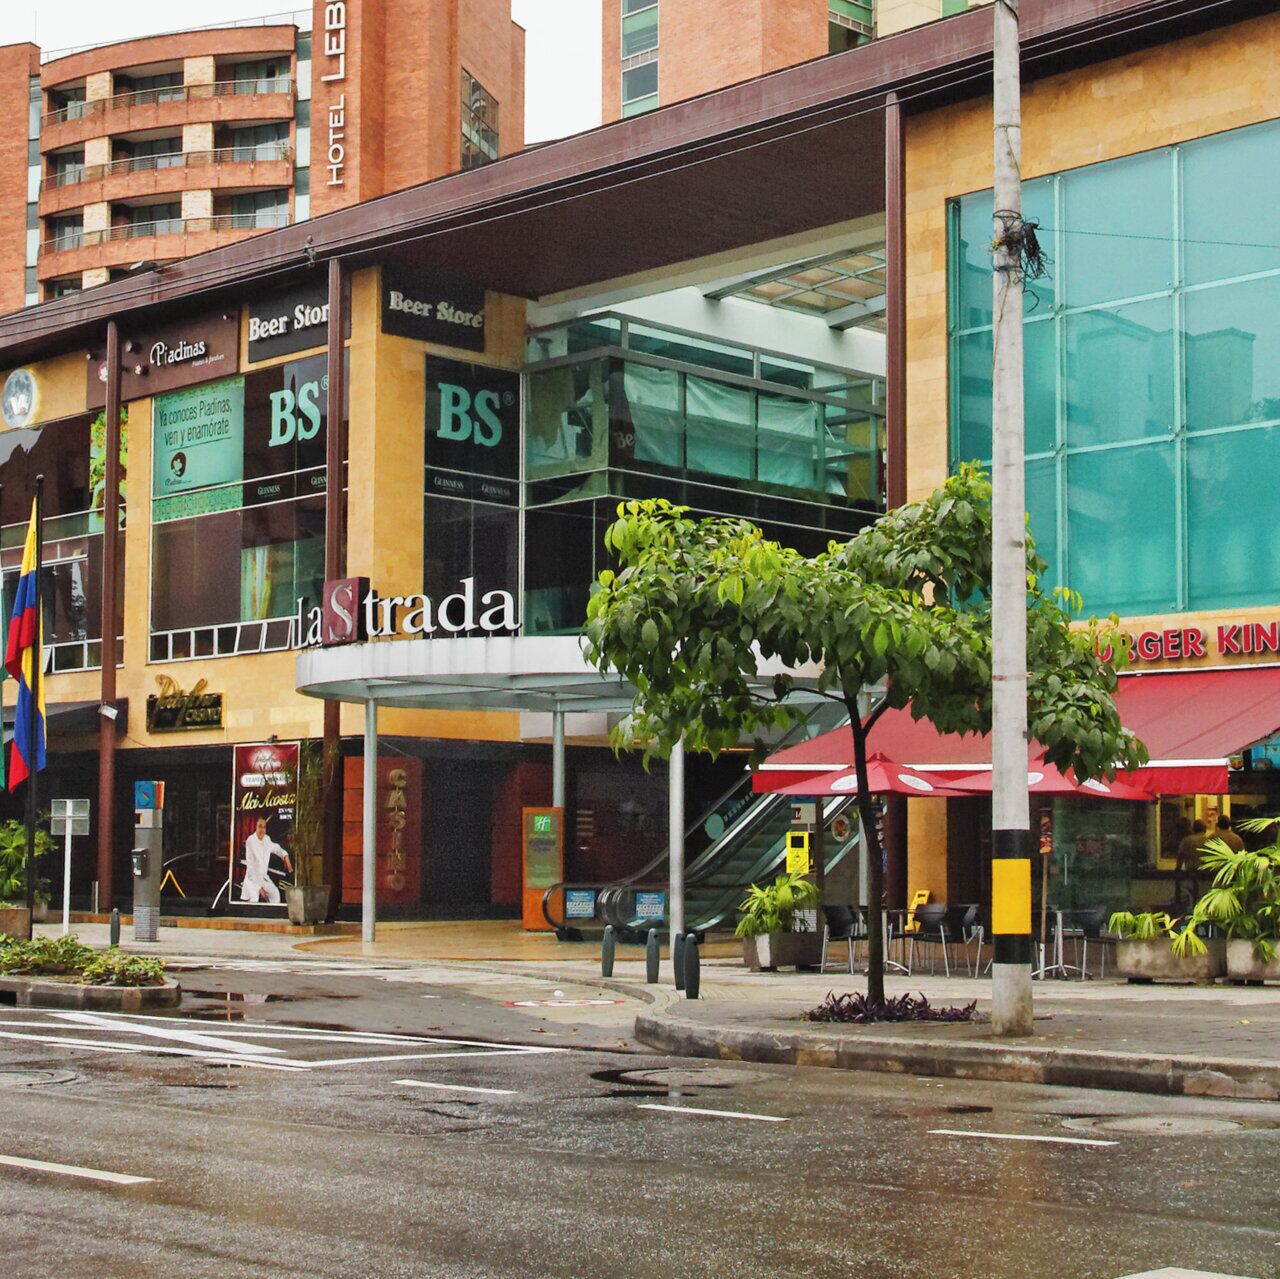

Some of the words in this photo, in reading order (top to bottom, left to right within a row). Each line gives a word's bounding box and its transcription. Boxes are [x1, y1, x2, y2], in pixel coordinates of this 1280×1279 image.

[327, 94, 345, 186] HOTEL
[248, 316, 288, 341] Beer
[293, 303, 328, 330] Stor
[388, 290, 433, 317] Beer
[436, 301, 484, 328] Store
[150, 341, 206, 366] Piadinas
[159, 410, 168, 427] Ya
[169, 406, 198, 425] conoces
[164, 432, 180, 447] ven
[180, 430, 186, 447] y
[187, 418, 230, 442] enamórate
[1095, 627, 1207, 662] URGER
